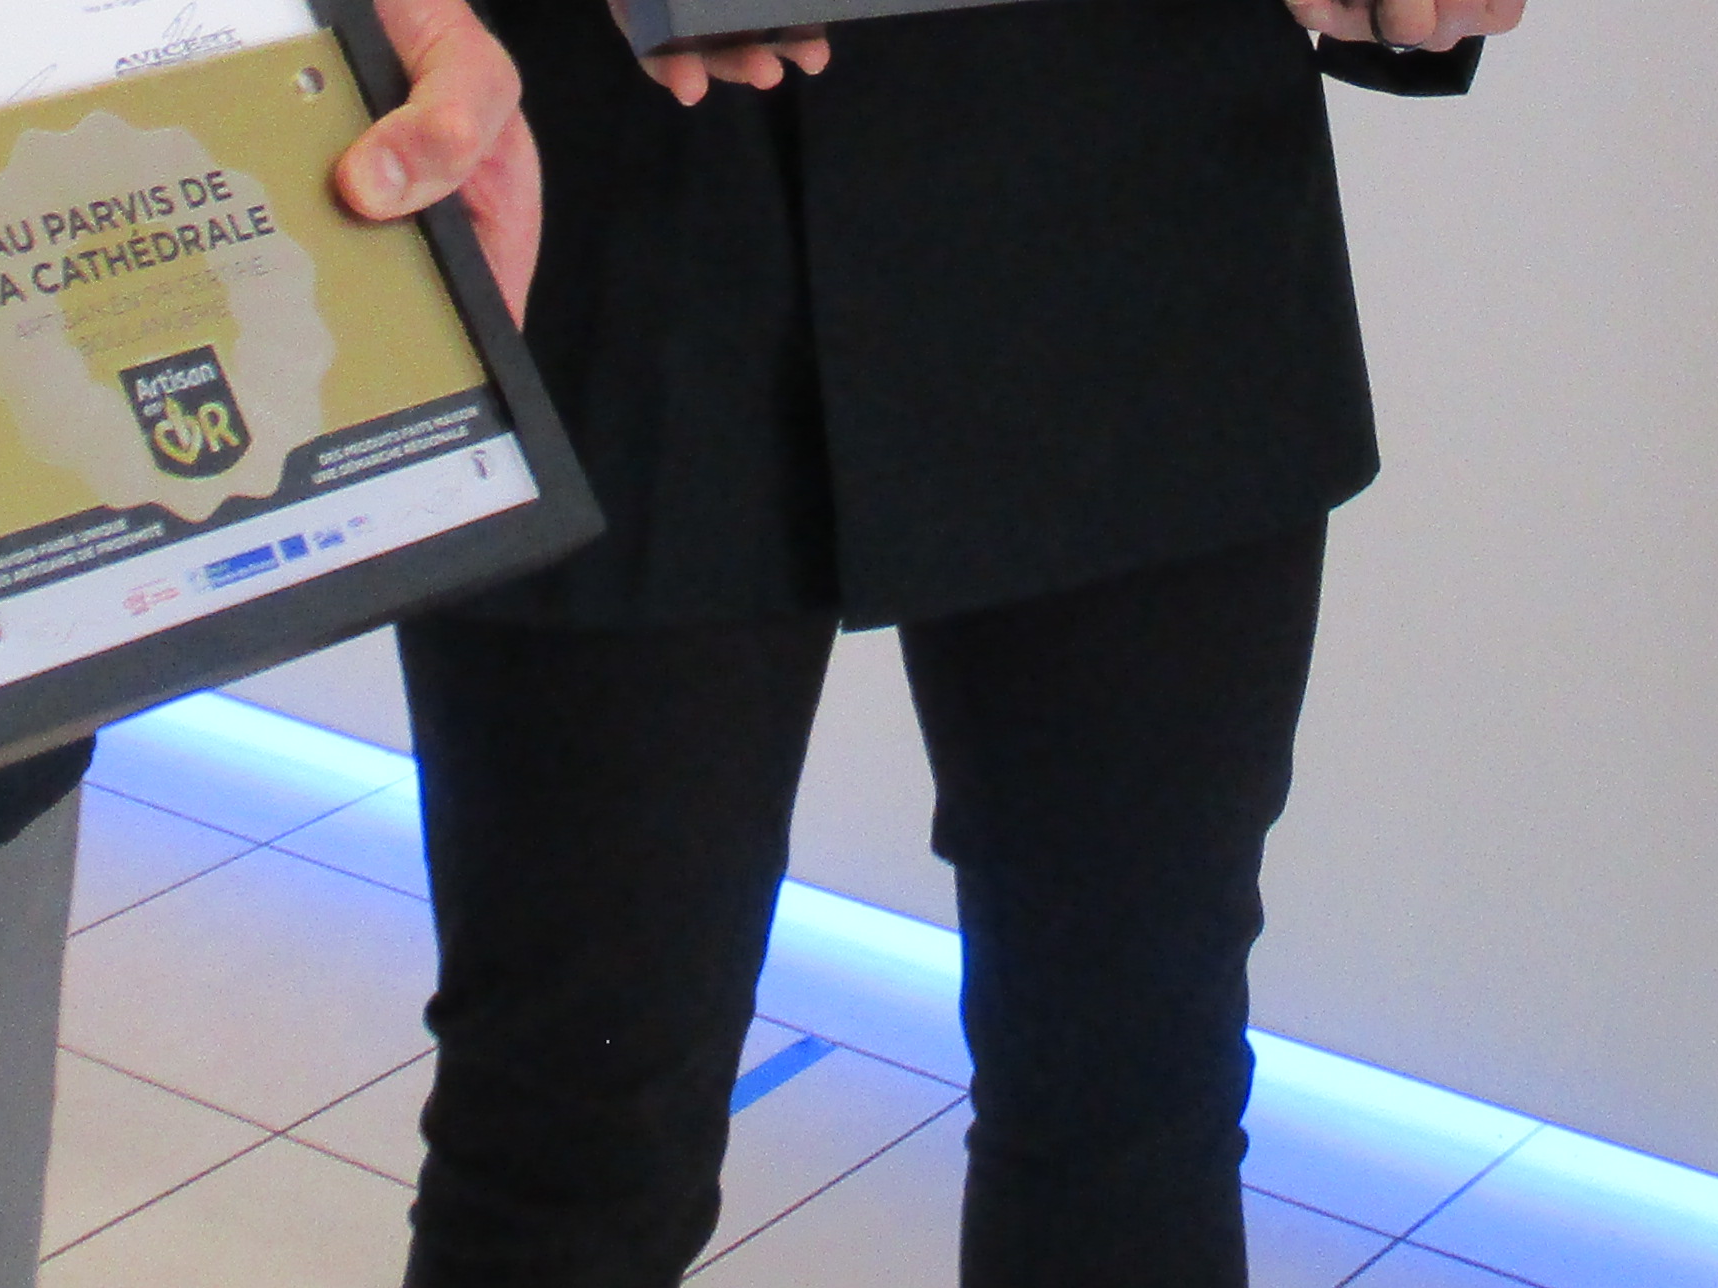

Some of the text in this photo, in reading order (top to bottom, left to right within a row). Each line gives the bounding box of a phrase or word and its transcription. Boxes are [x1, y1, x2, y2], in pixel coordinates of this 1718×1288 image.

[41, 185, 175, 243] PARVIS
[178, 169, 233, 209] DE
[30, 203, 277, 295] CATHÉDRALE
